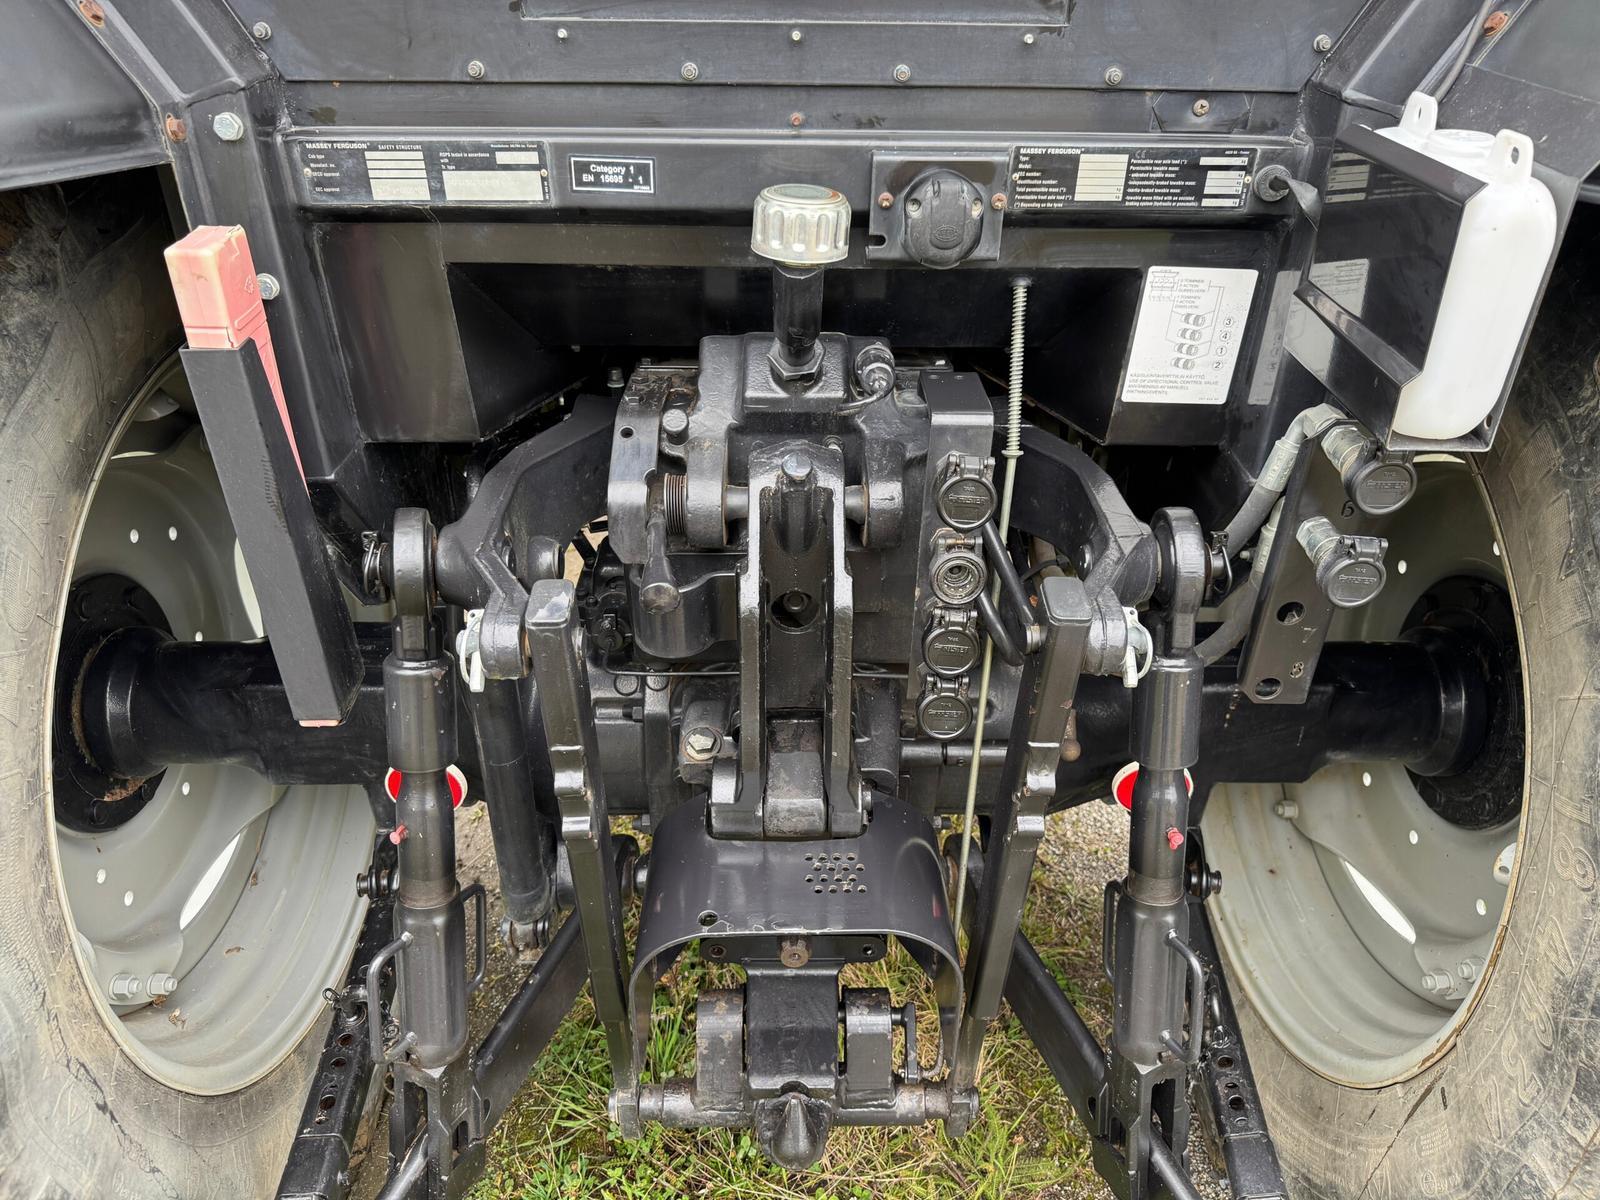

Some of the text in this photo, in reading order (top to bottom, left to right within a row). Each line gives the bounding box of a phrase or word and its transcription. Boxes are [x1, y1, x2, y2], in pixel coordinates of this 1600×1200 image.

[305, 142, 332, 150] MASSEY
[590, 164, 634, 174] Category 1
[582, 173, 594, 182] EN
[638, 176, 643, 184] 1
